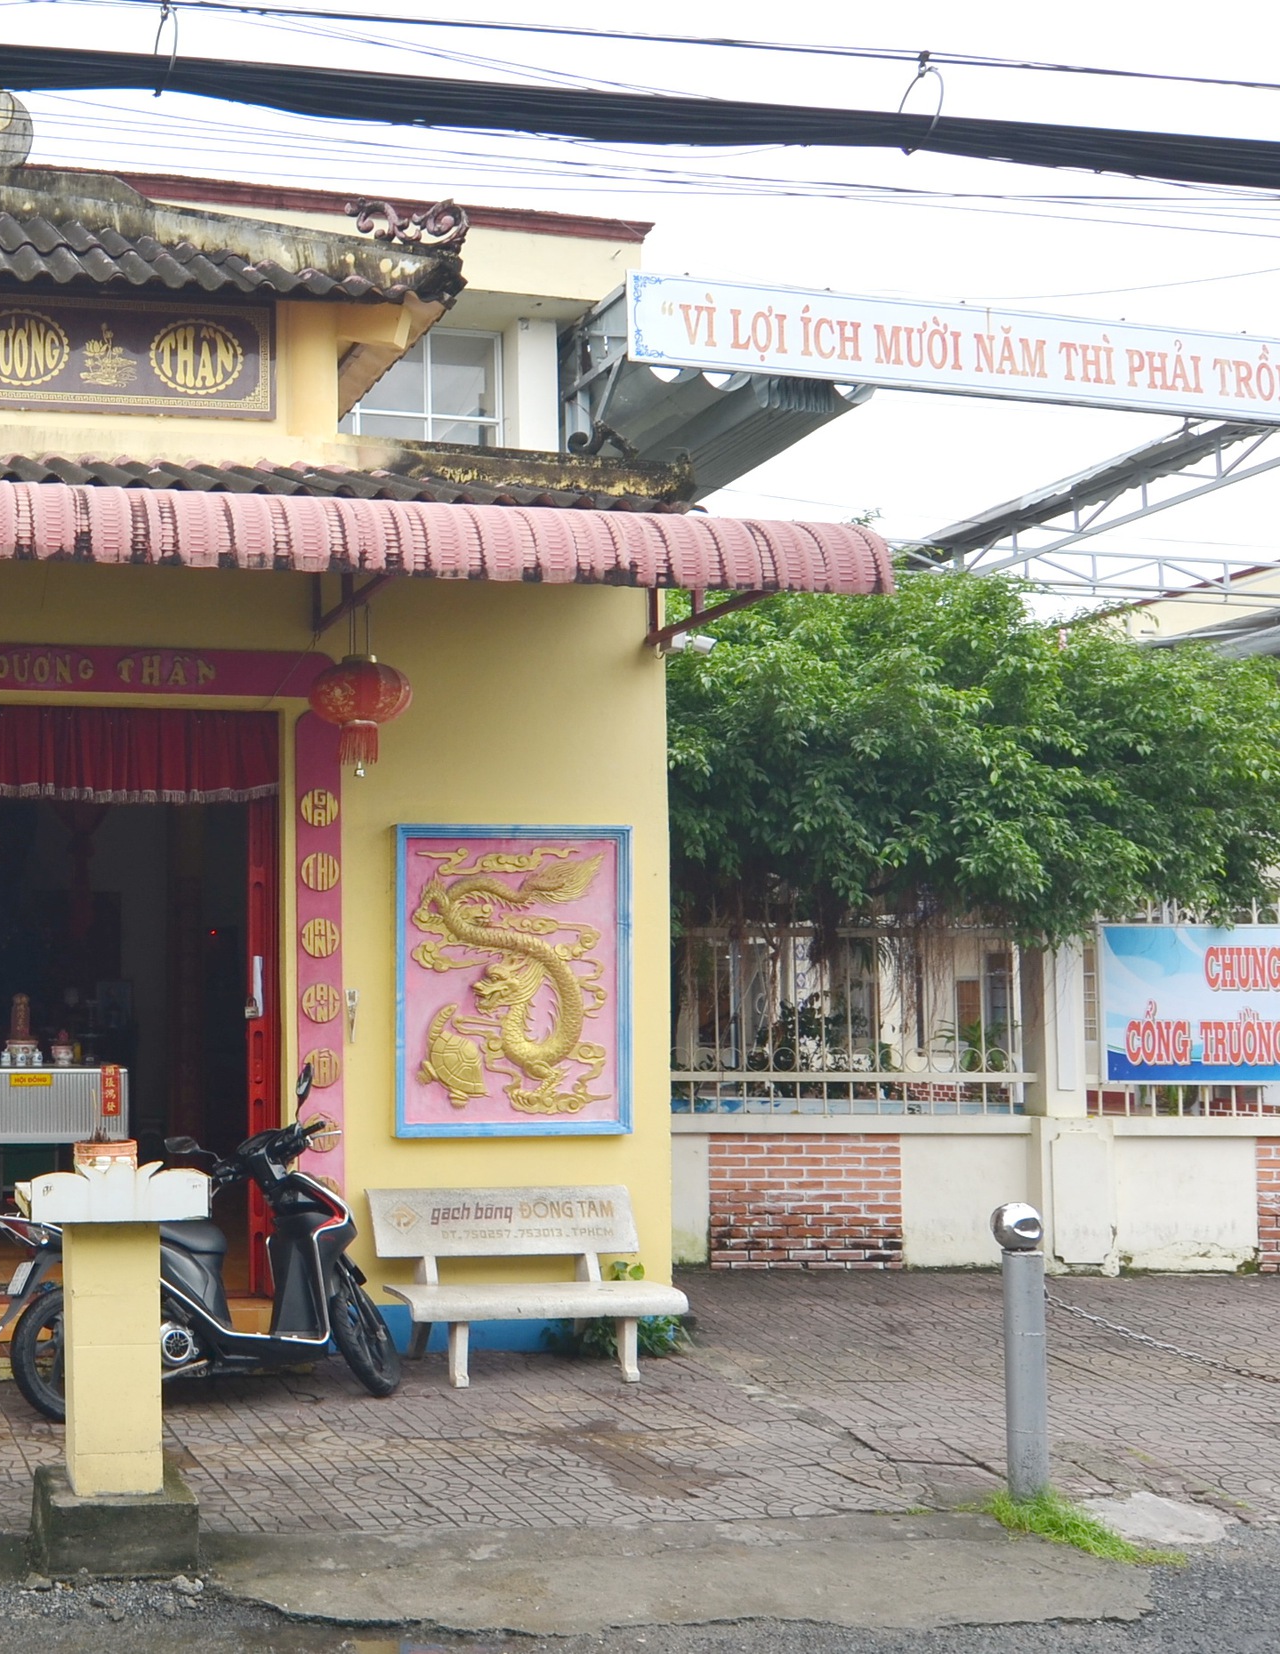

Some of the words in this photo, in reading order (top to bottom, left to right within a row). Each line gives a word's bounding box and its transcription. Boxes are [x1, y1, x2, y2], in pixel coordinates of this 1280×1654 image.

[158, 324, 233, 388] THẦN
[730, 308, 788, 363] LỢI
[801, 305, 863, 361] ÍCH
[873, 316, 963, 372] MƯỜI
[974, 326, 1048, 378] NĂM
[1058, 335, 1116, 386] THÌ
[1126, 340, 1204, 393] PHẢI
[1213, 344, 1280, 401] TRỒ
[118, 654, 216, 686] THẦN
[301, 852, 340, 891] THU
[301, 918, 340, 958] DANH
[302, 984, 340, 1023] RẠNG
[1126, 1000, 1191, 1064] CỔNG
